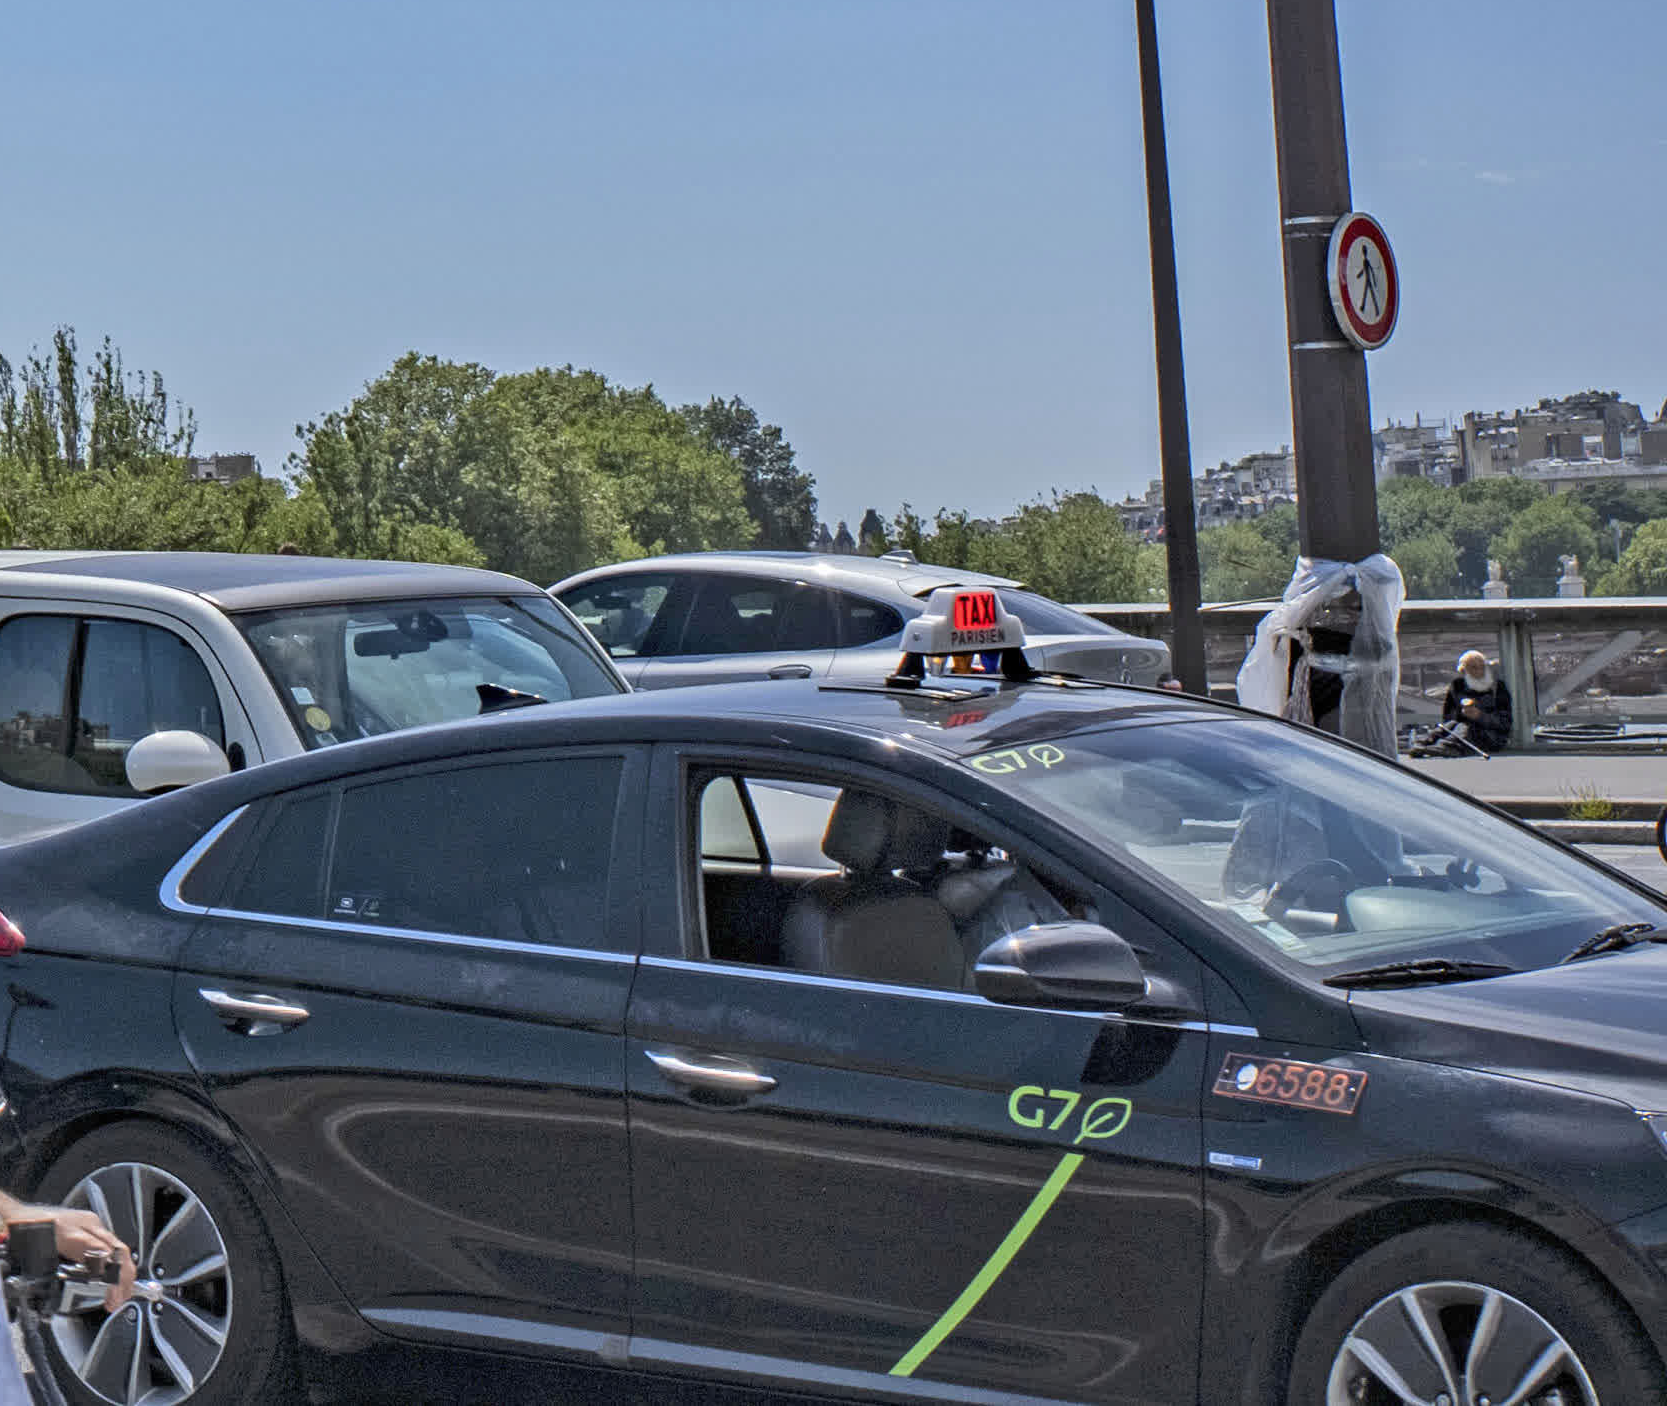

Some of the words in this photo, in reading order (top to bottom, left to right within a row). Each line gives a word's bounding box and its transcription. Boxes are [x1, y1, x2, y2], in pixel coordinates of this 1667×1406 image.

[959, 594, 997, 627] TAXI
[951, 628, 1006, 646] PARISIEN
[971, 749, 1028, 774] G7
[1256, 1062, 1350, 1106] 6588
[1008, 1085, 1082, 1130] G7
